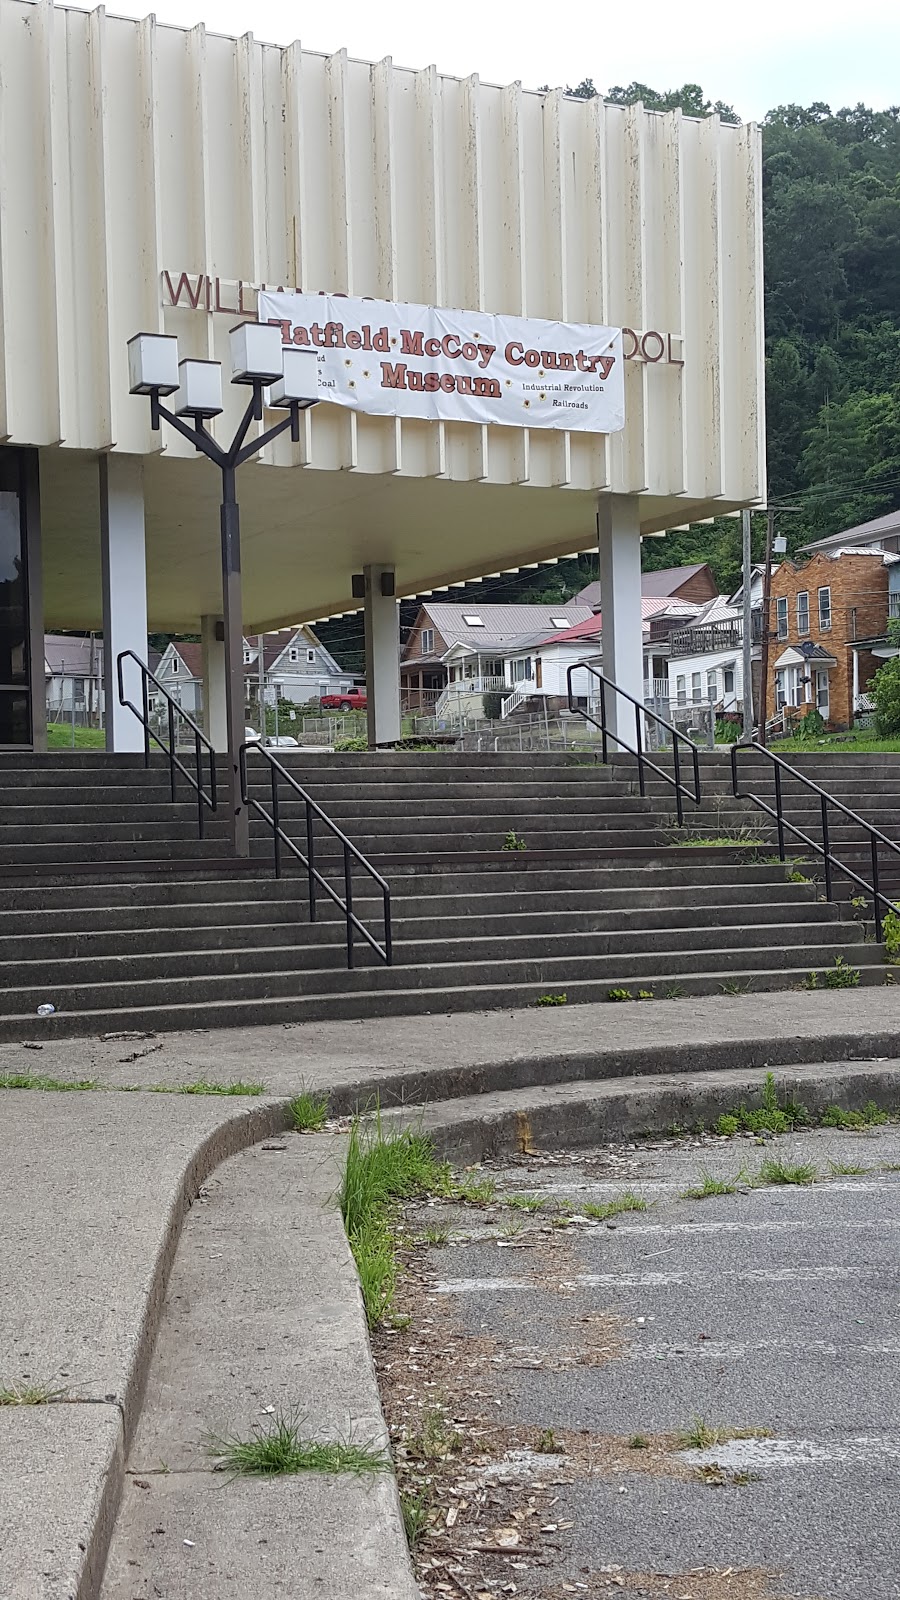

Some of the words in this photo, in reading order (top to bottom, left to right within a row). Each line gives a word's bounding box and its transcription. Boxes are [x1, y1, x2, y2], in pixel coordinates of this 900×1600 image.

[400, 330, 496, 368] McCoy
[504, 341, 615, 380] Country
[622, 327, 684, 364] OOL
[380, 362, 502, 398] Museum
[522, 383, 561, 392] Industrial
[563, 384, 605, 392] Revolution
[552, 399, 589, 409] Railroads
